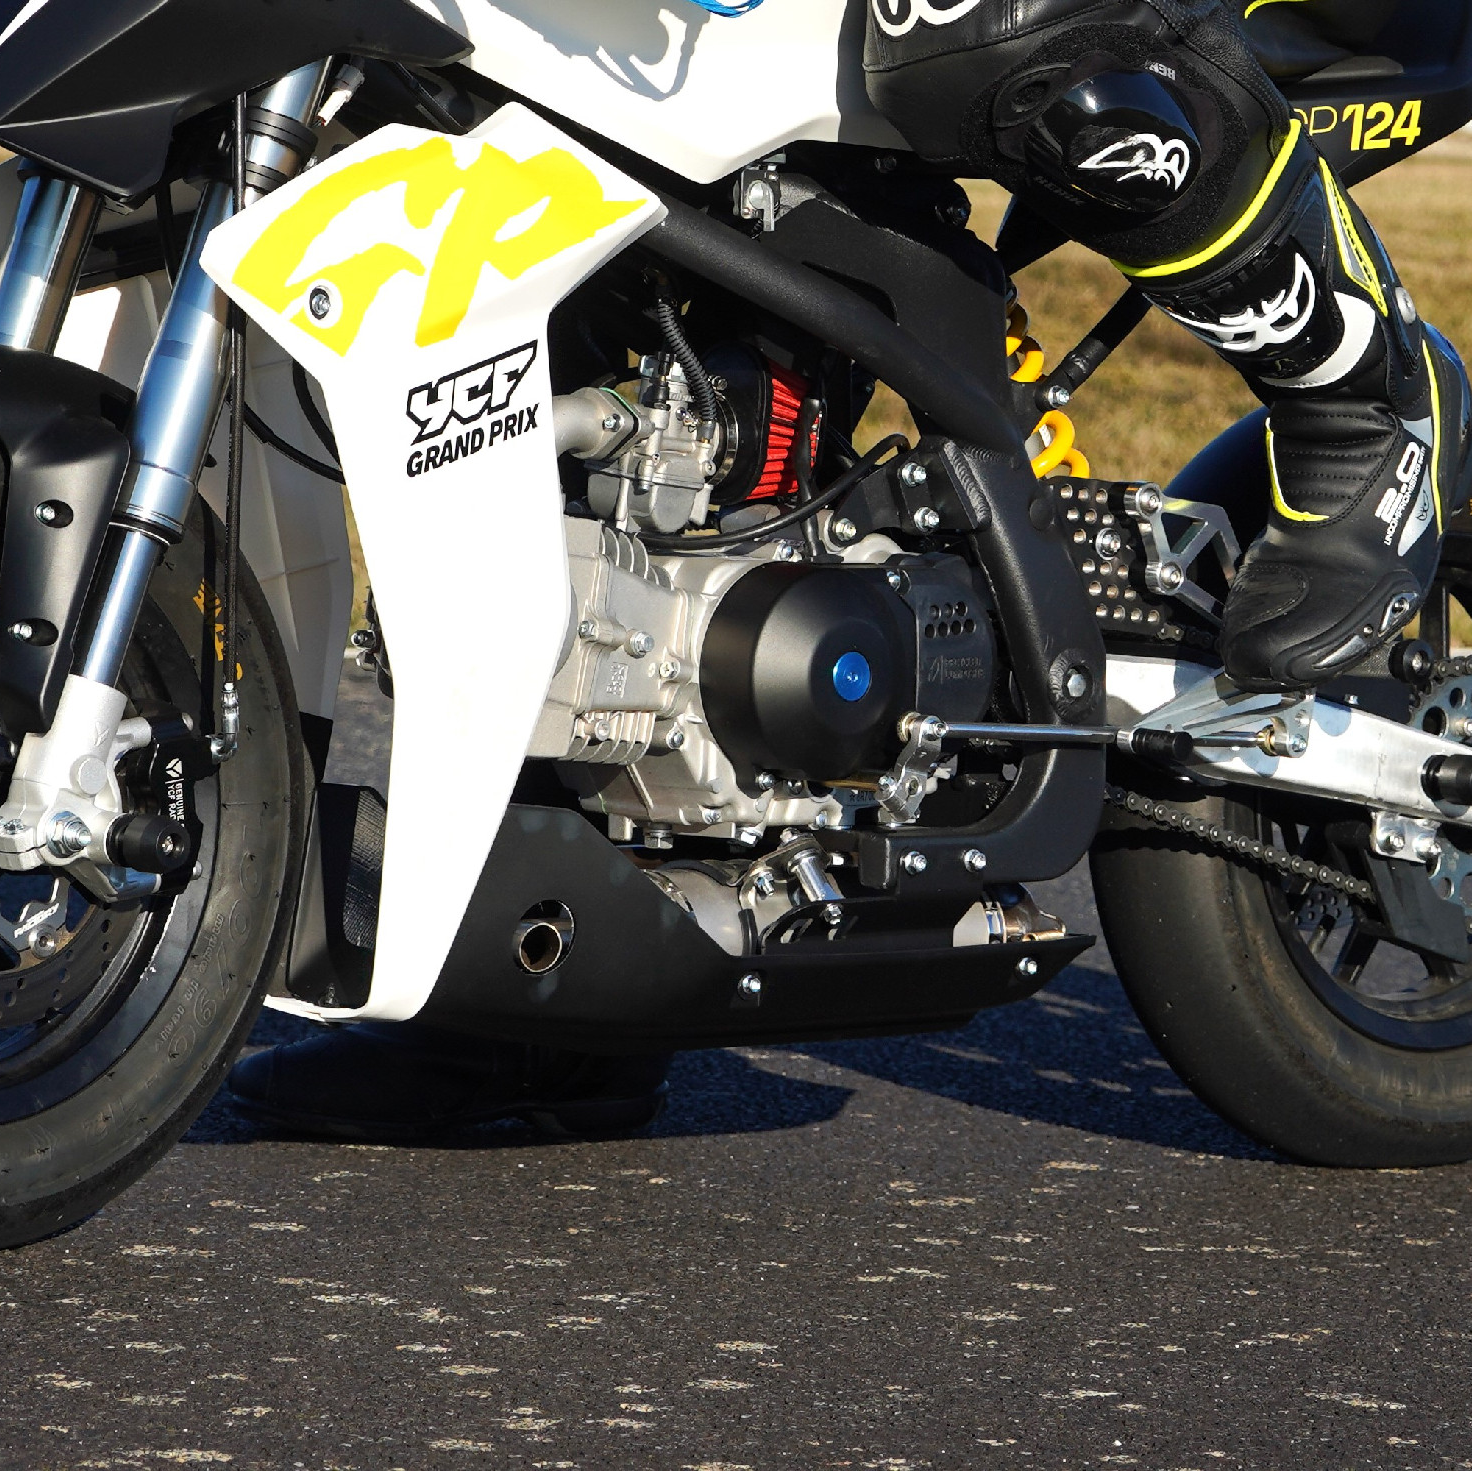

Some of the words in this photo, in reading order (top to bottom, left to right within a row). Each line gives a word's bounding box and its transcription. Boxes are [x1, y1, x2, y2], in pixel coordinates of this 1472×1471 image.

[1341, 99, 1422, 152] 124
[406, 339, 539, 446] YCF
[406, 427, 485, 478] GRAND
[488, 402, 541, 448] PRIX
[1374, 441, 1421, 524] 2.0
[167, 783, 176, 800] YCF
